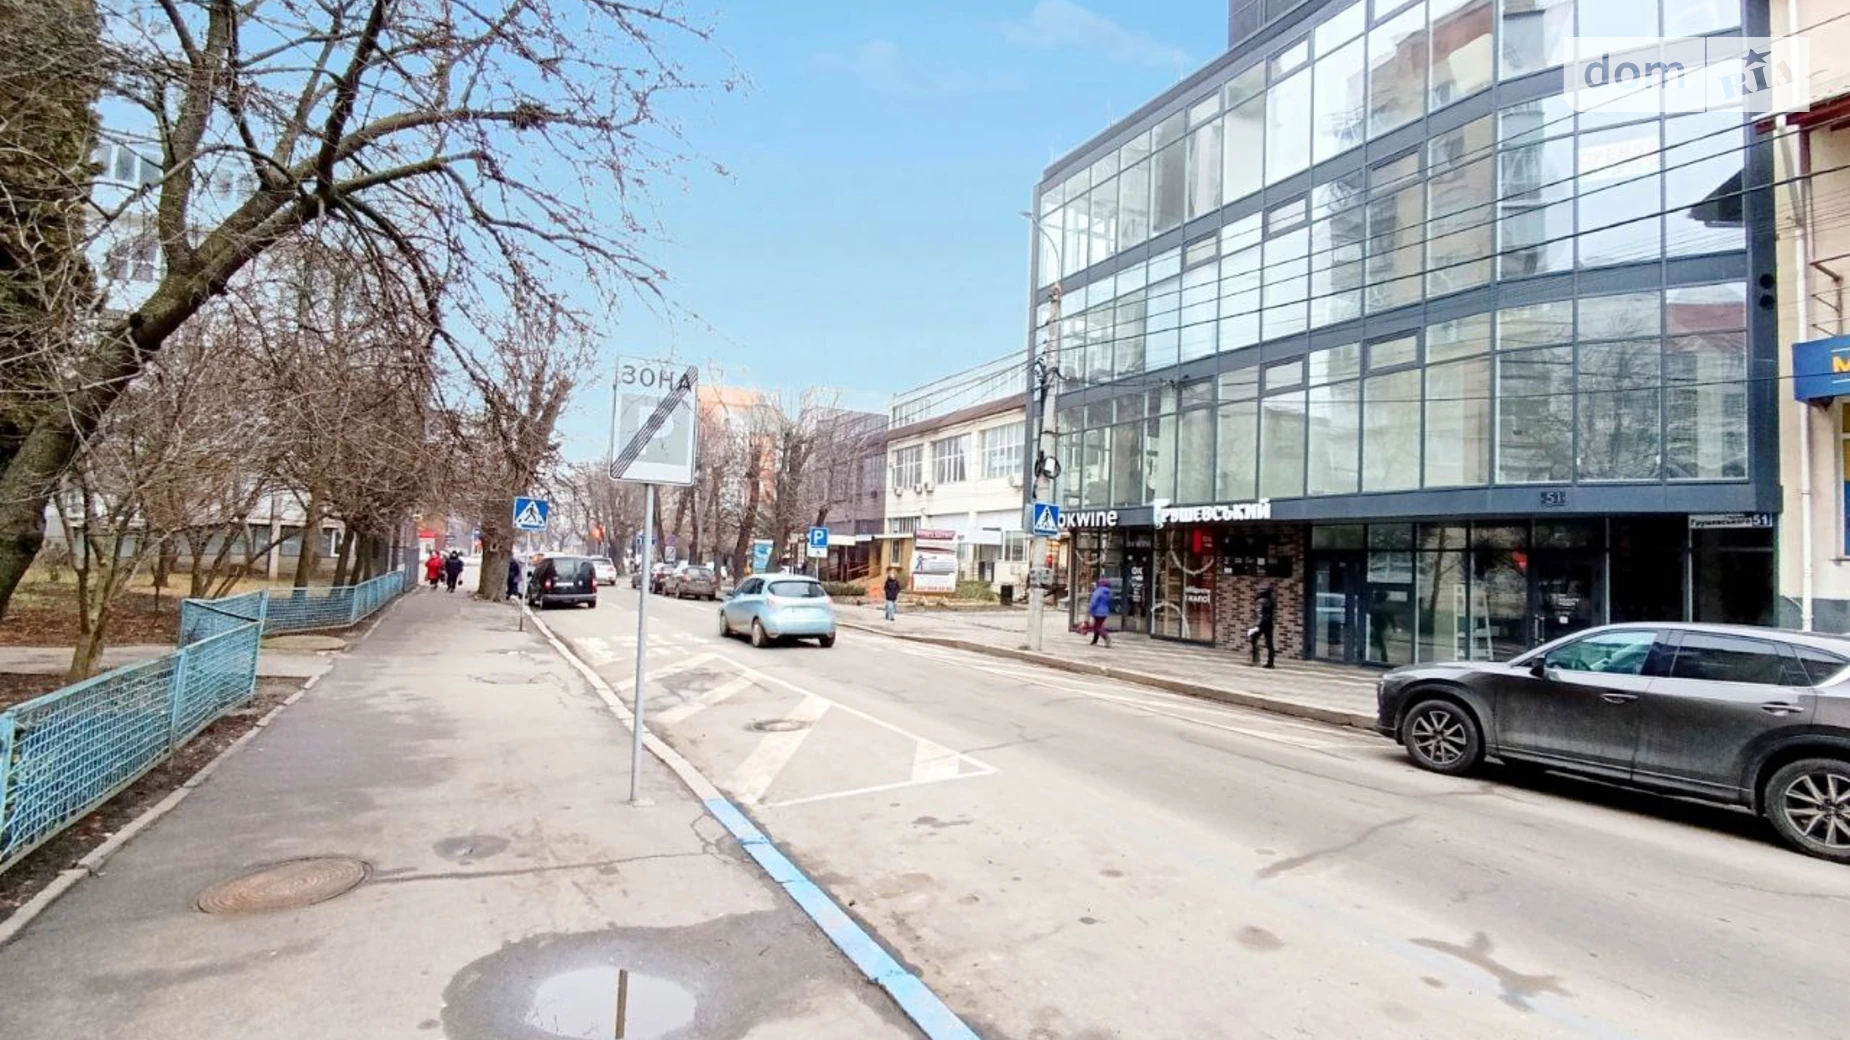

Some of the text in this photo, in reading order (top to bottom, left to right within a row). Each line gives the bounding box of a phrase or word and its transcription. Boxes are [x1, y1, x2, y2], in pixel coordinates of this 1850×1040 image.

[621, 364, 692, 392] ЗОНА
[1546, 492, 1561, 504] 51
[1752, 514, 1769, 526] 51
[813, 530, 824, 544] P
